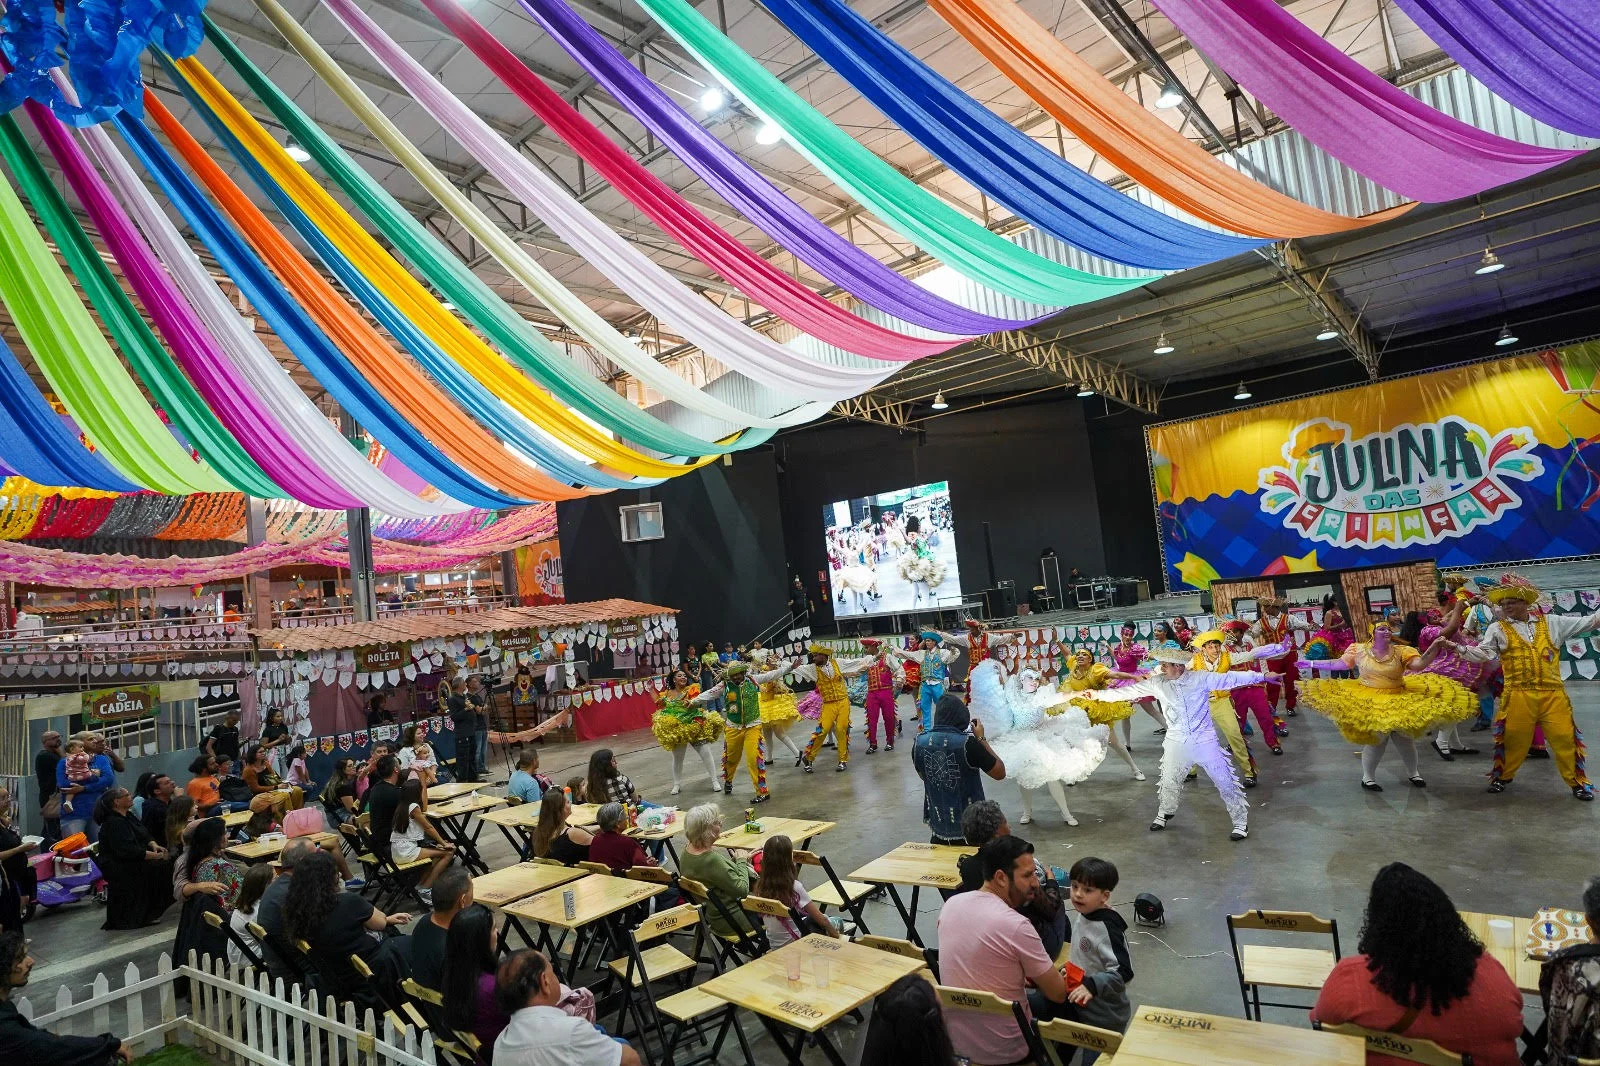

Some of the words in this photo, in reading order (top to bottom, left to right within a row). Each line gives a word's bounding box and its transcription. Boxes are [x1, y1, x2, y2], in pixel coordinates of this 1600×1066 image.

[1305, 421, 1483, 504] JULINA
[1301, 484, 1501, 532] CRIANÇAS
[1363, 489, 1421, 511] DAS
[367, 651, 400, 663] ROLETA
[100, 700, 144, 715] CADEIA
